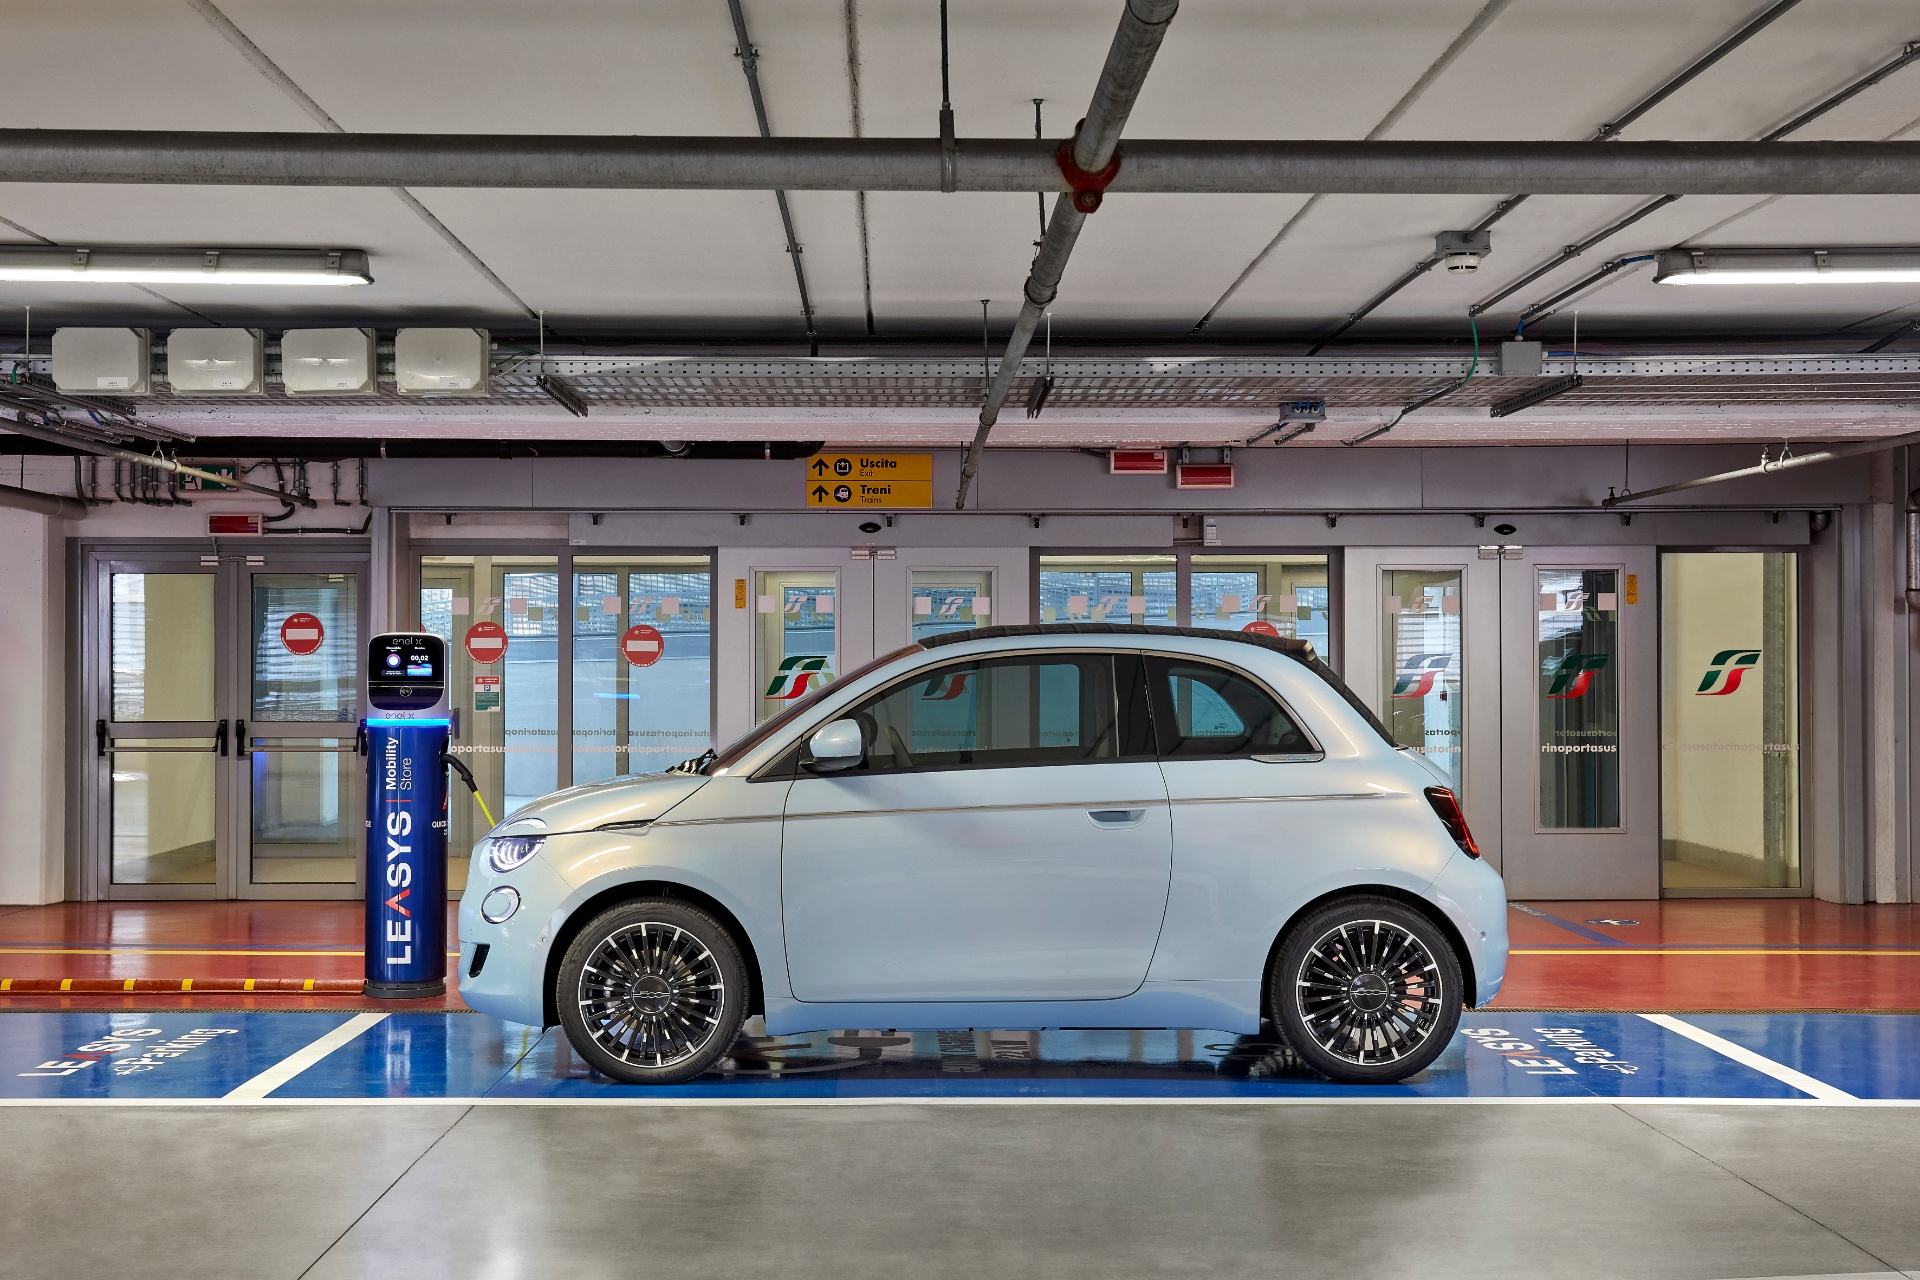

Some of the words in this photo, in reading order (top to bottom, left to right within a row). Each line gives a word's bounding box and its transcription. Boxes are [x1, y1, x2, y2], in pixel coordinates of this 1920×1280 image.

[860, 458, 897, 468] Uscita
[860, 469, 873, 477] Exit
[860, 484, 891, 495] Treni
[860, 495, 882, 504] Trains
[392, 636, 413, 645] enel
[385, 712, 406, 720] enel
[1541, 742, 1617, 755] rinoportasus
[385, 736, 399, 790] Mobility
[400, 757, 412, 790] Store
[385, 810, 412, 965] LEASYS
[17, 1028, 162, 1077] LEASYS
[1460, 1028, 1579, 1075] LEASYS
